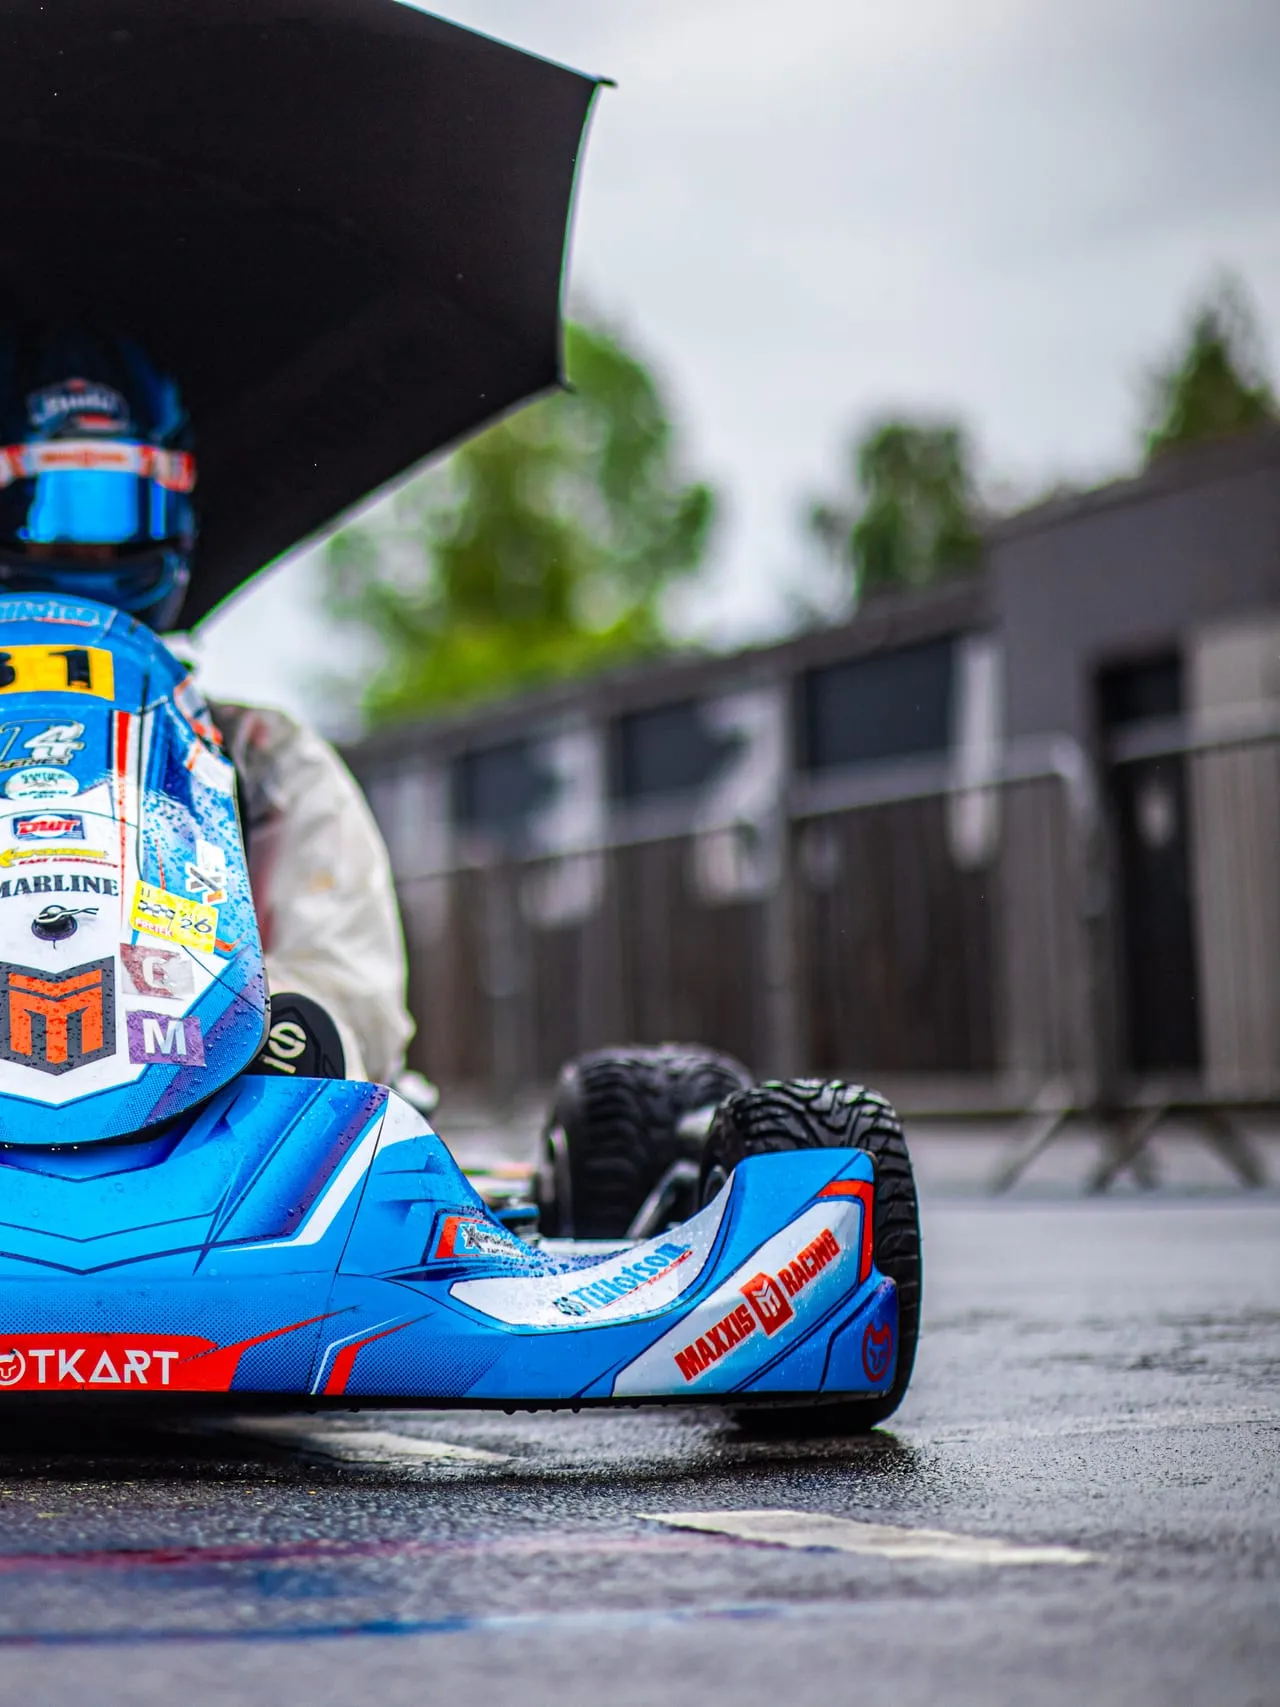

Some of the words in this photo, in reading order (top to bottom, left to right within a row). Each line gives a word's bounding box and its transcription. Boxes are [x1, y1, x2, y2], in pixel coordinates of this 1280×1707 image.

[142, 1017, 187, 1056] M
[568, 1242, 691, 1309] Tillotson
[674, 1304, 757, 1382] MAXXIS
[777, 1228, 851, 1297] RACING
